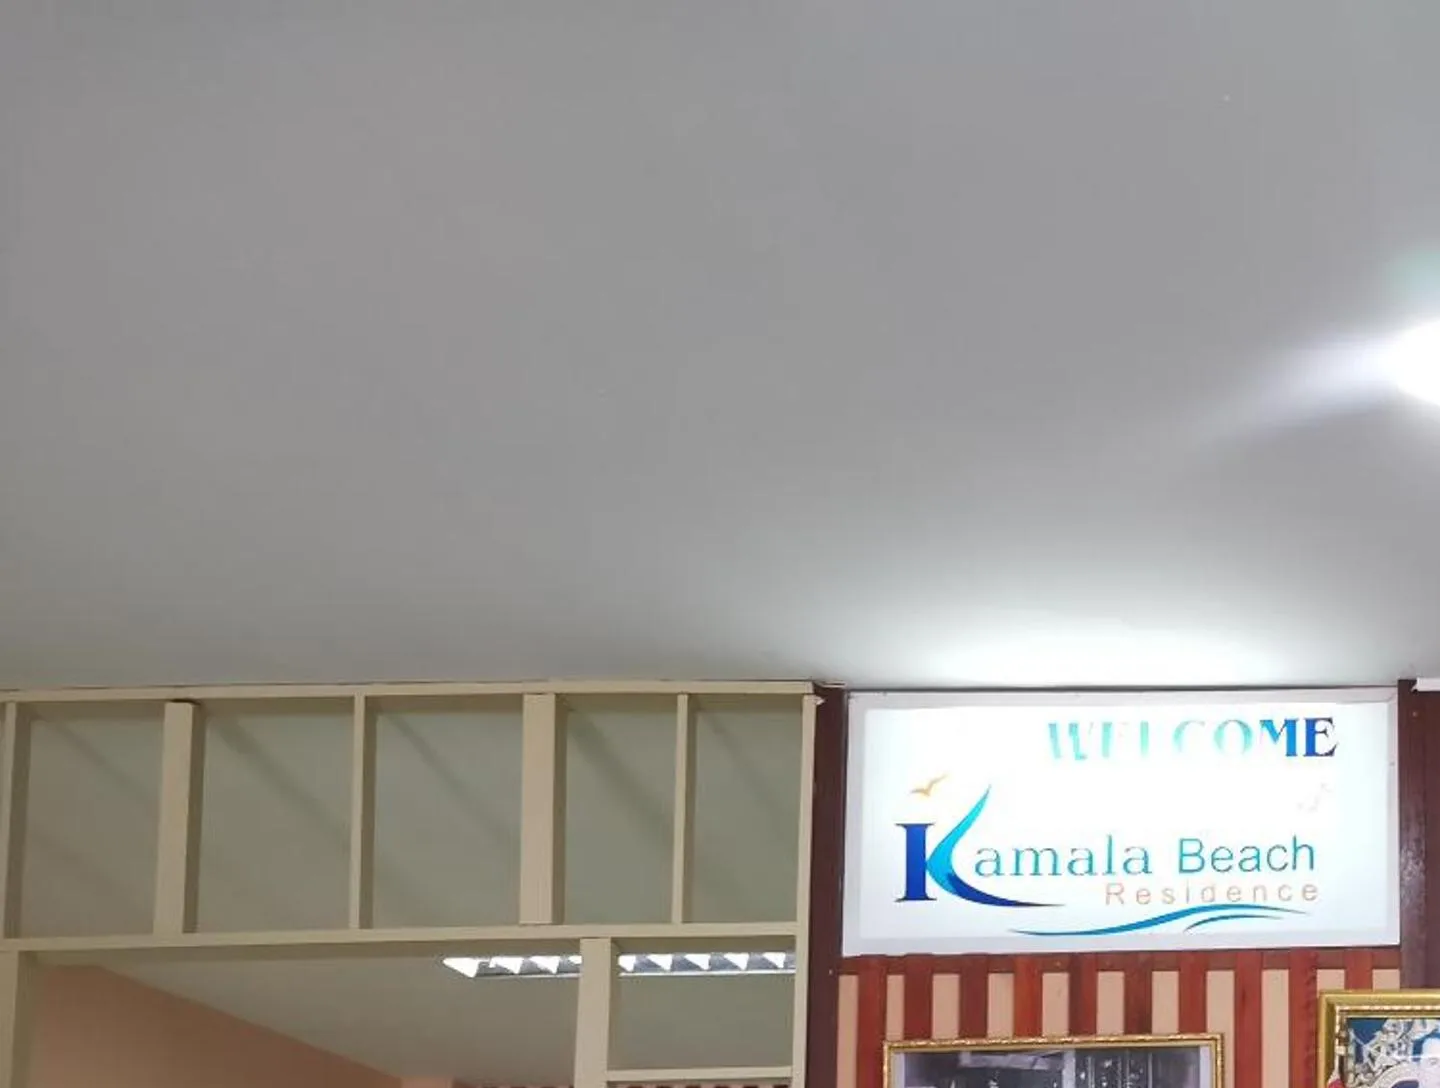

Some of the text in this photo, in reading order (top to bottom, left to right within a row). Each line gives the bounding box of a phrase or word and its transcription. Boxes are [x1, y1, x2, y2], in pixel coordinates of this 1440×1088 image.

[894, 783, 1316, 907] Kamala Beach
[1104, 881, 1320, 906] Residence
